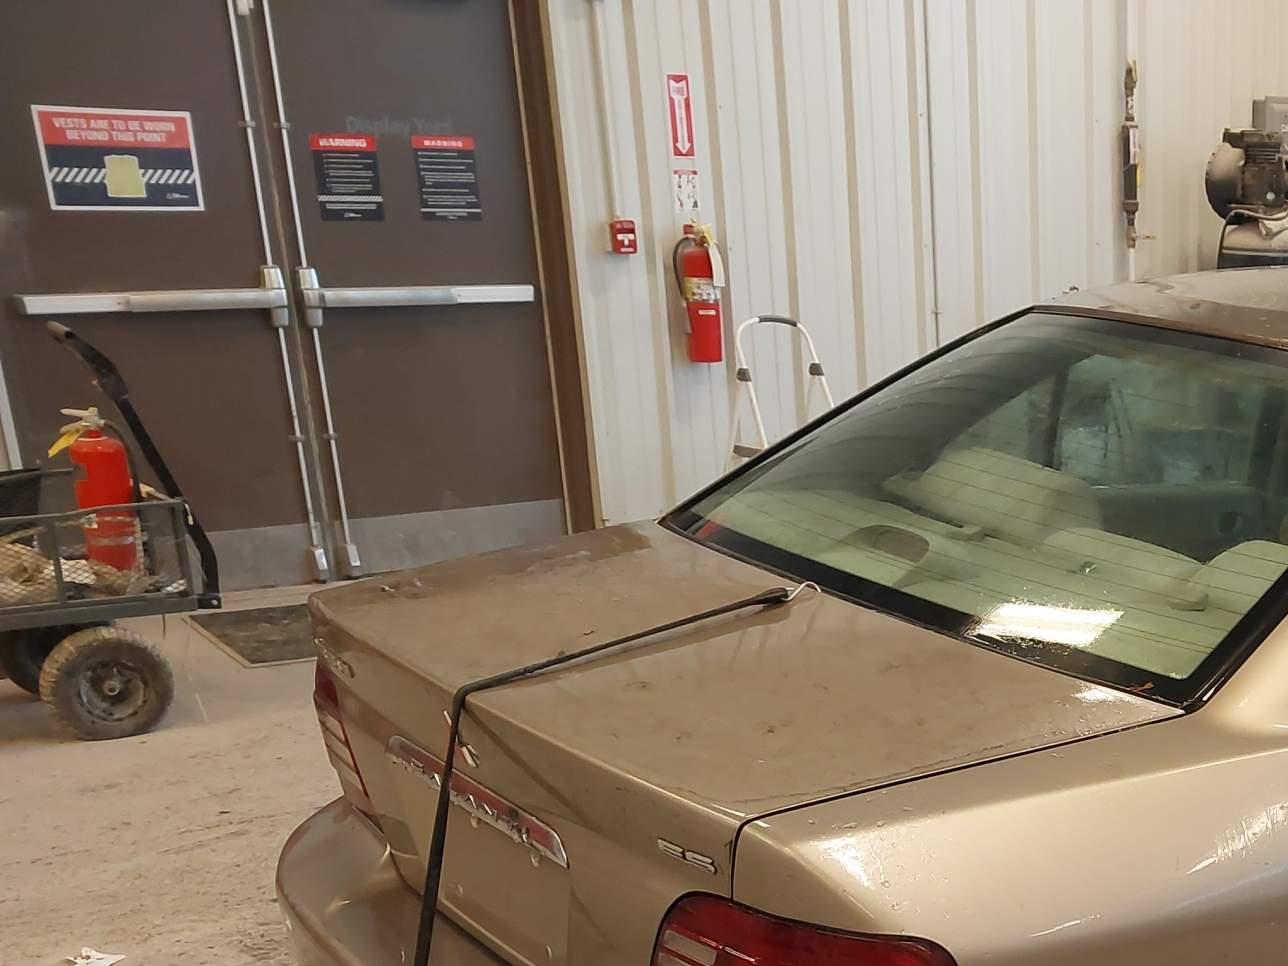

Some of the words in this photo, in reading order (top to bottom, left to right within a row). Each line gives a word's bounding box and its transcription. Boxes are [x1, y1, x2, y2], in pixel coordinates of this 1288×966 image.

[52, 117, 87, 129] VESTS
[90, 119, 110, 129] ARE
[112, 120, 126, 130] TO
[128, 121, 142, 131] BE
[142, 121, 176, 132] WORN
[65, 130, 109, 141] BEYOND
[111, 131, 135, 142] THIS
[136, 132, 167, 143] POINT
[318, 138, 367, 147] WARNING
[657, 837, 718, 875] ES
